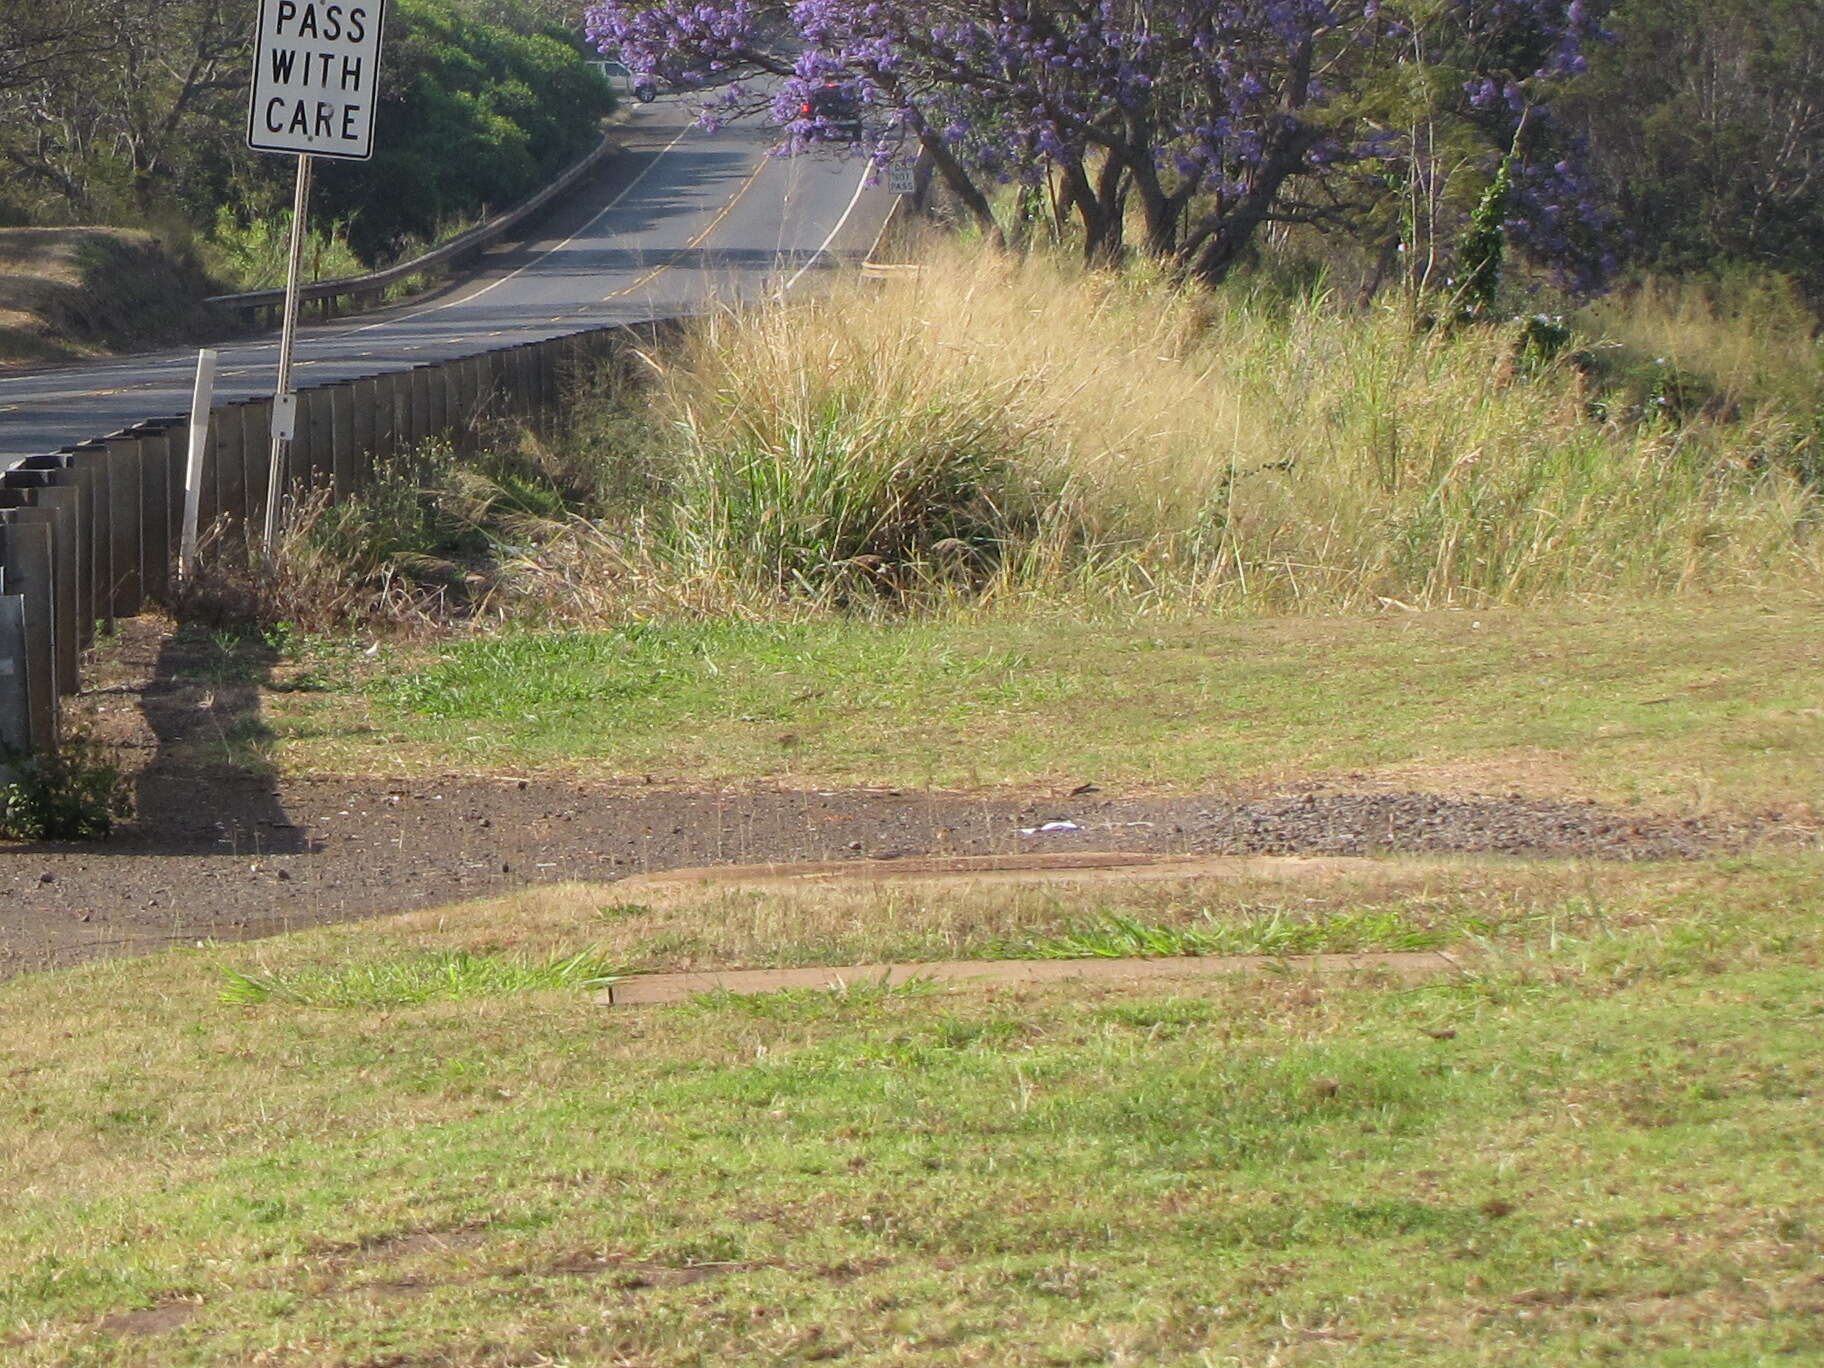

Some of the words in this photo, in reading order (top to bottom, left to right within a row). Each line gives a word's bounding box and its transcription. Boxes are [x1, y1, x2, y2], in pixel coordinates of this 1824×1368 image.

[276, 0, 366, 43] PASS
[272, 48, 362, 91] WITH
[266, 96, 360, 140] CARE
[891, 182, 913, 191] PASS
